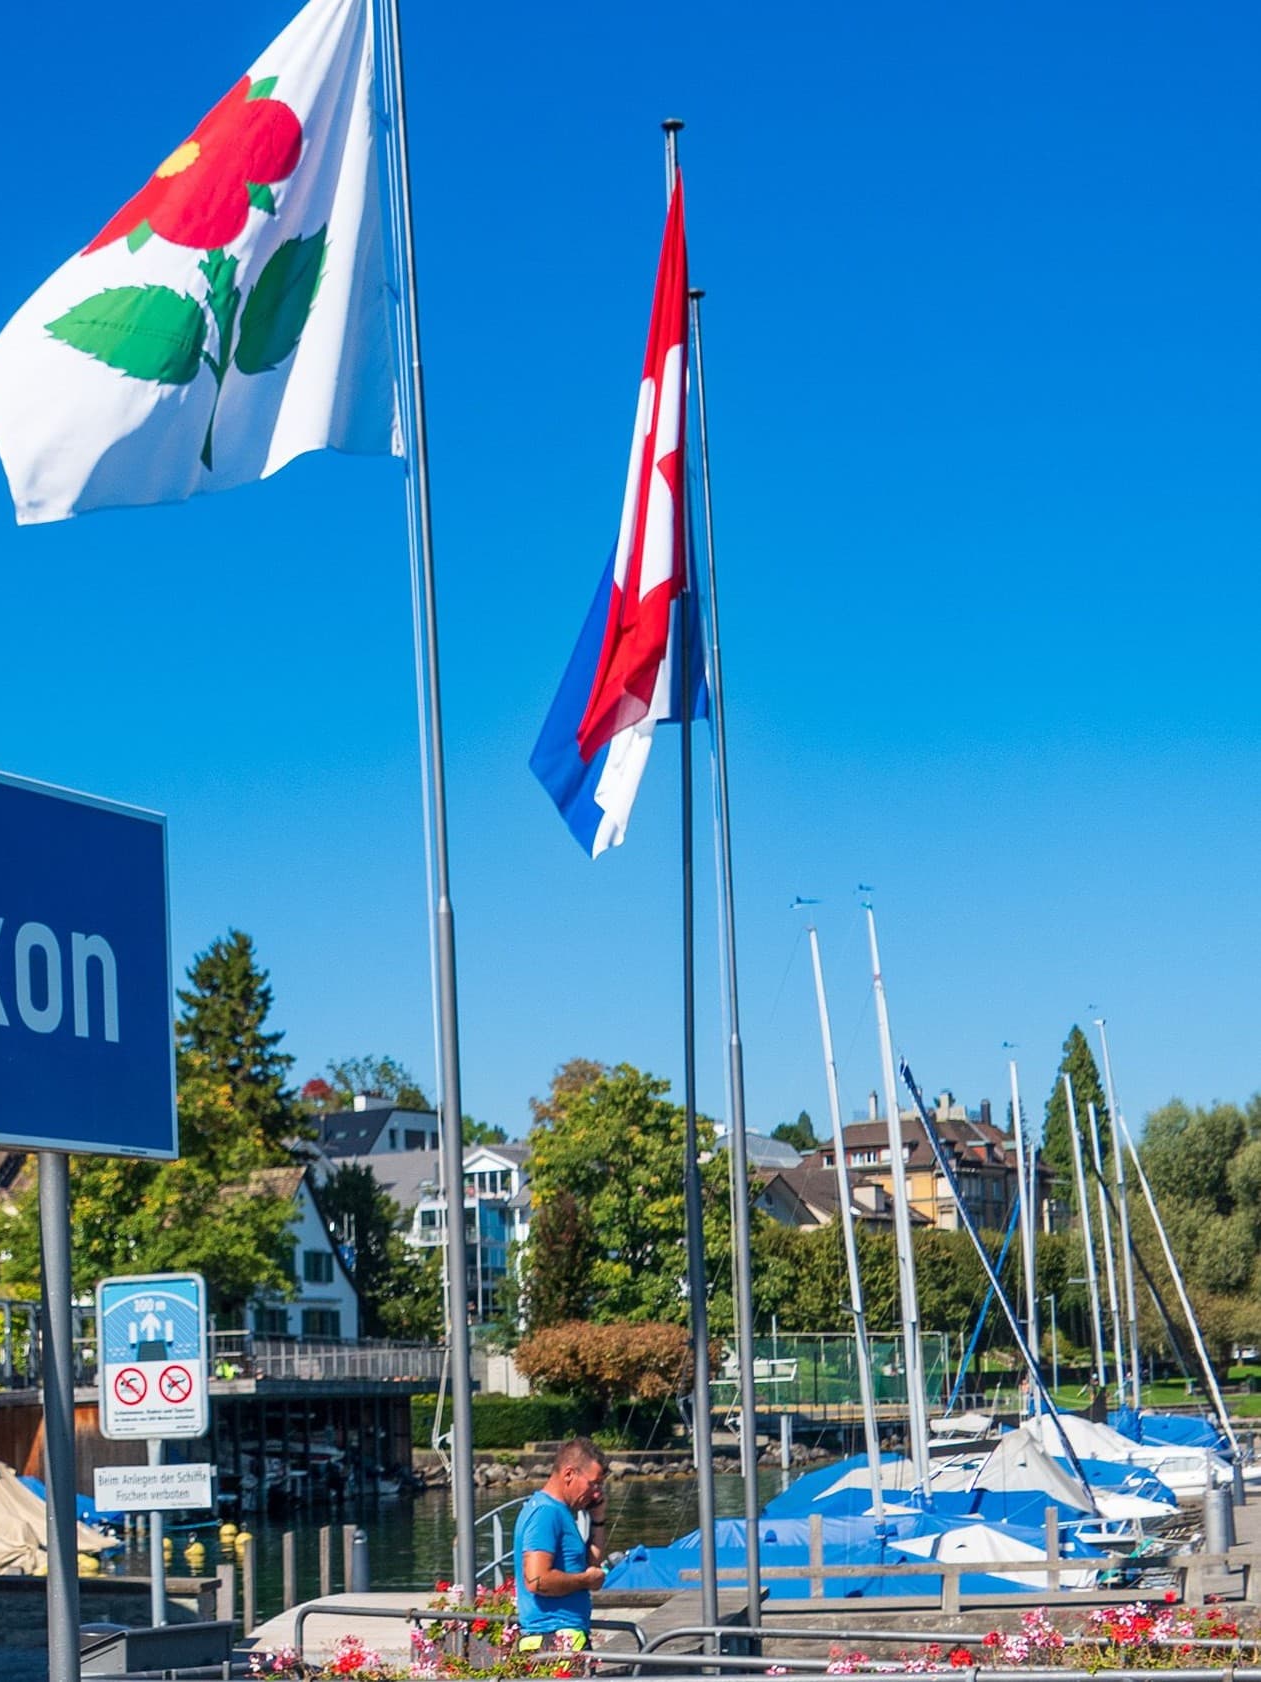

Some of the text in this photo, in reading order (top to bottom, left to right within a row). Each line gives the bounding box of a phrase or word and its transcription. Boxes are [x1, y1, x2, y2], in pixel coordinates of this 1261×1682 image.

[98, 1470, 207, 1488] Beim Anlegen der Schiffe
[116, 1489, 191, 1501] Fischen verboten
